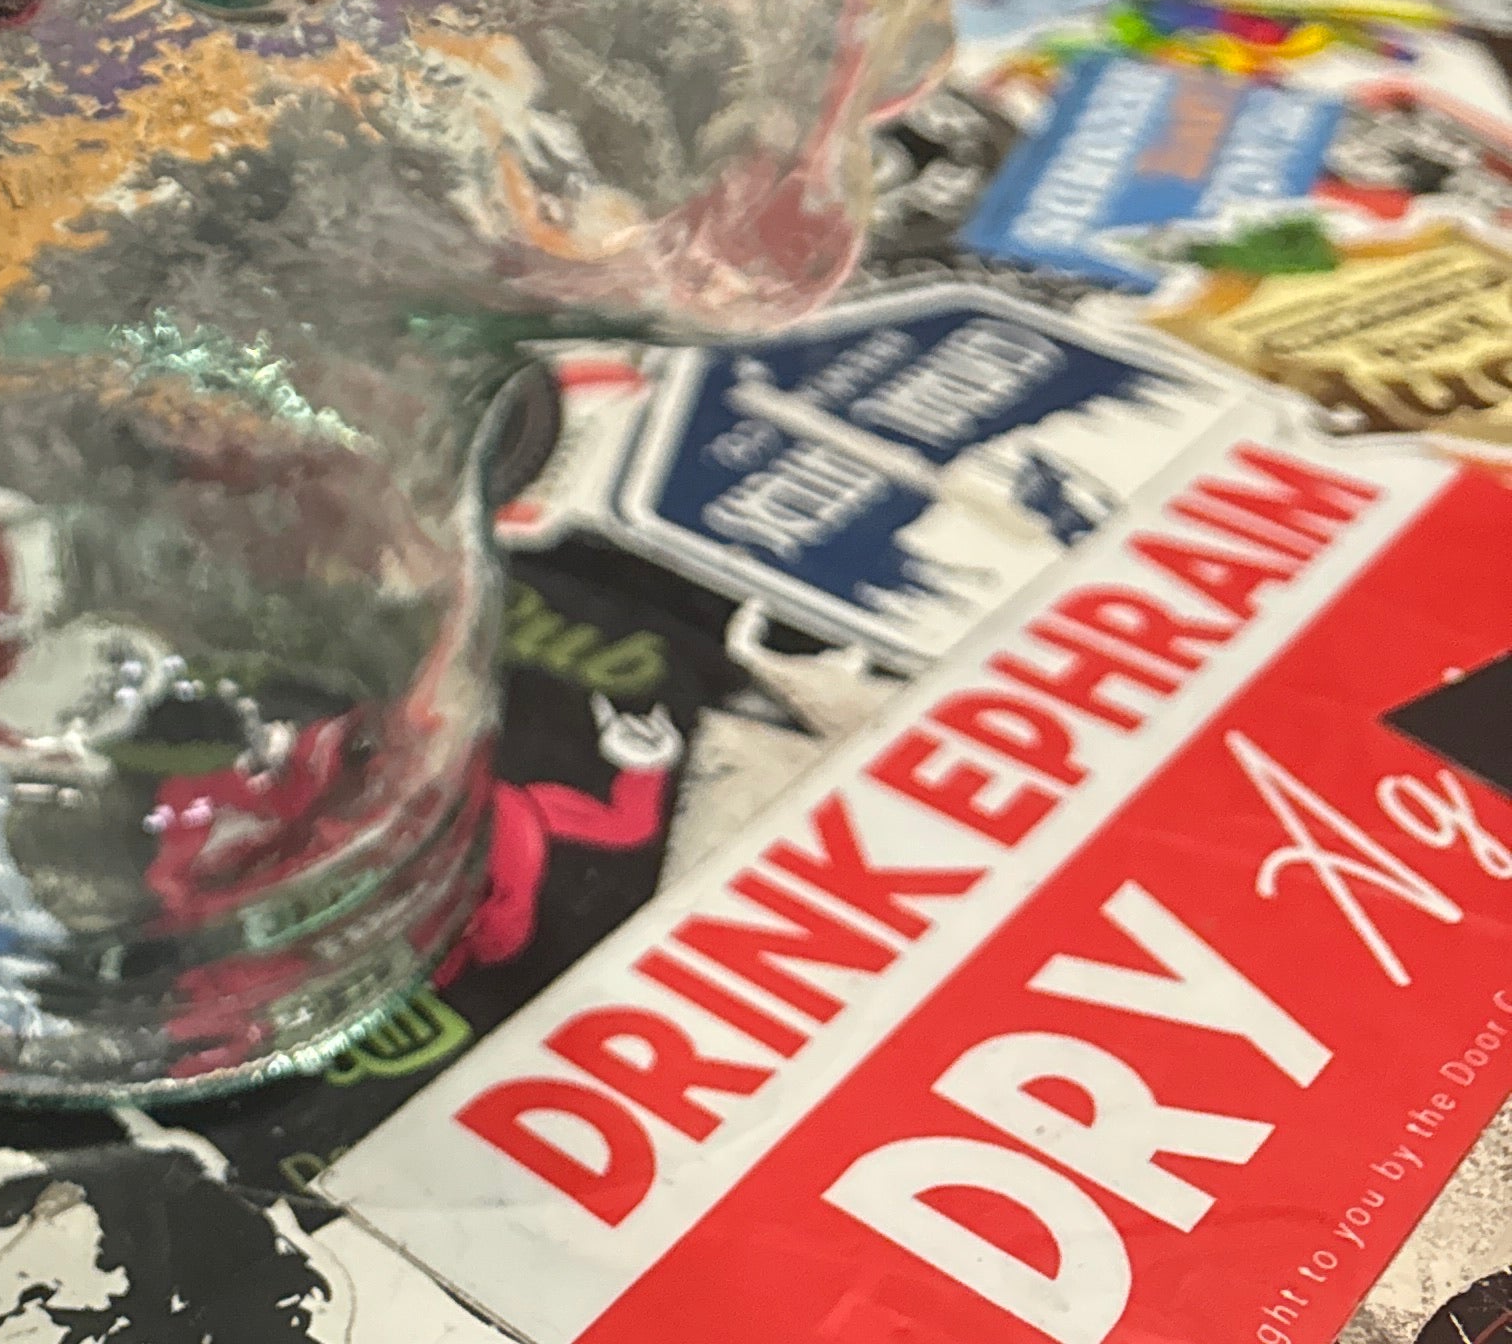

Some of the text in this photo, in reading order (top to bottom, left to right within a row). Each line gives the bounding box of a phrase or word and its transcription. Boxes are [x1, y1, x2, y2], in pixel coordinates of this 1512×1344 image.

[453, 788, 994, 1228] DRINK
[864, 440, 1390, 849] EPHRAIM
[821, 879, 1335, 1344] DRY
[1297, 1248, 1338, 1283] to
[1332, 1188, 1385, 1250] you
[1369, 1143, 1424, 1182] by
[1405, 1090, 1457, 1138] the
[1438, 1017, 1508, 1088] Door
